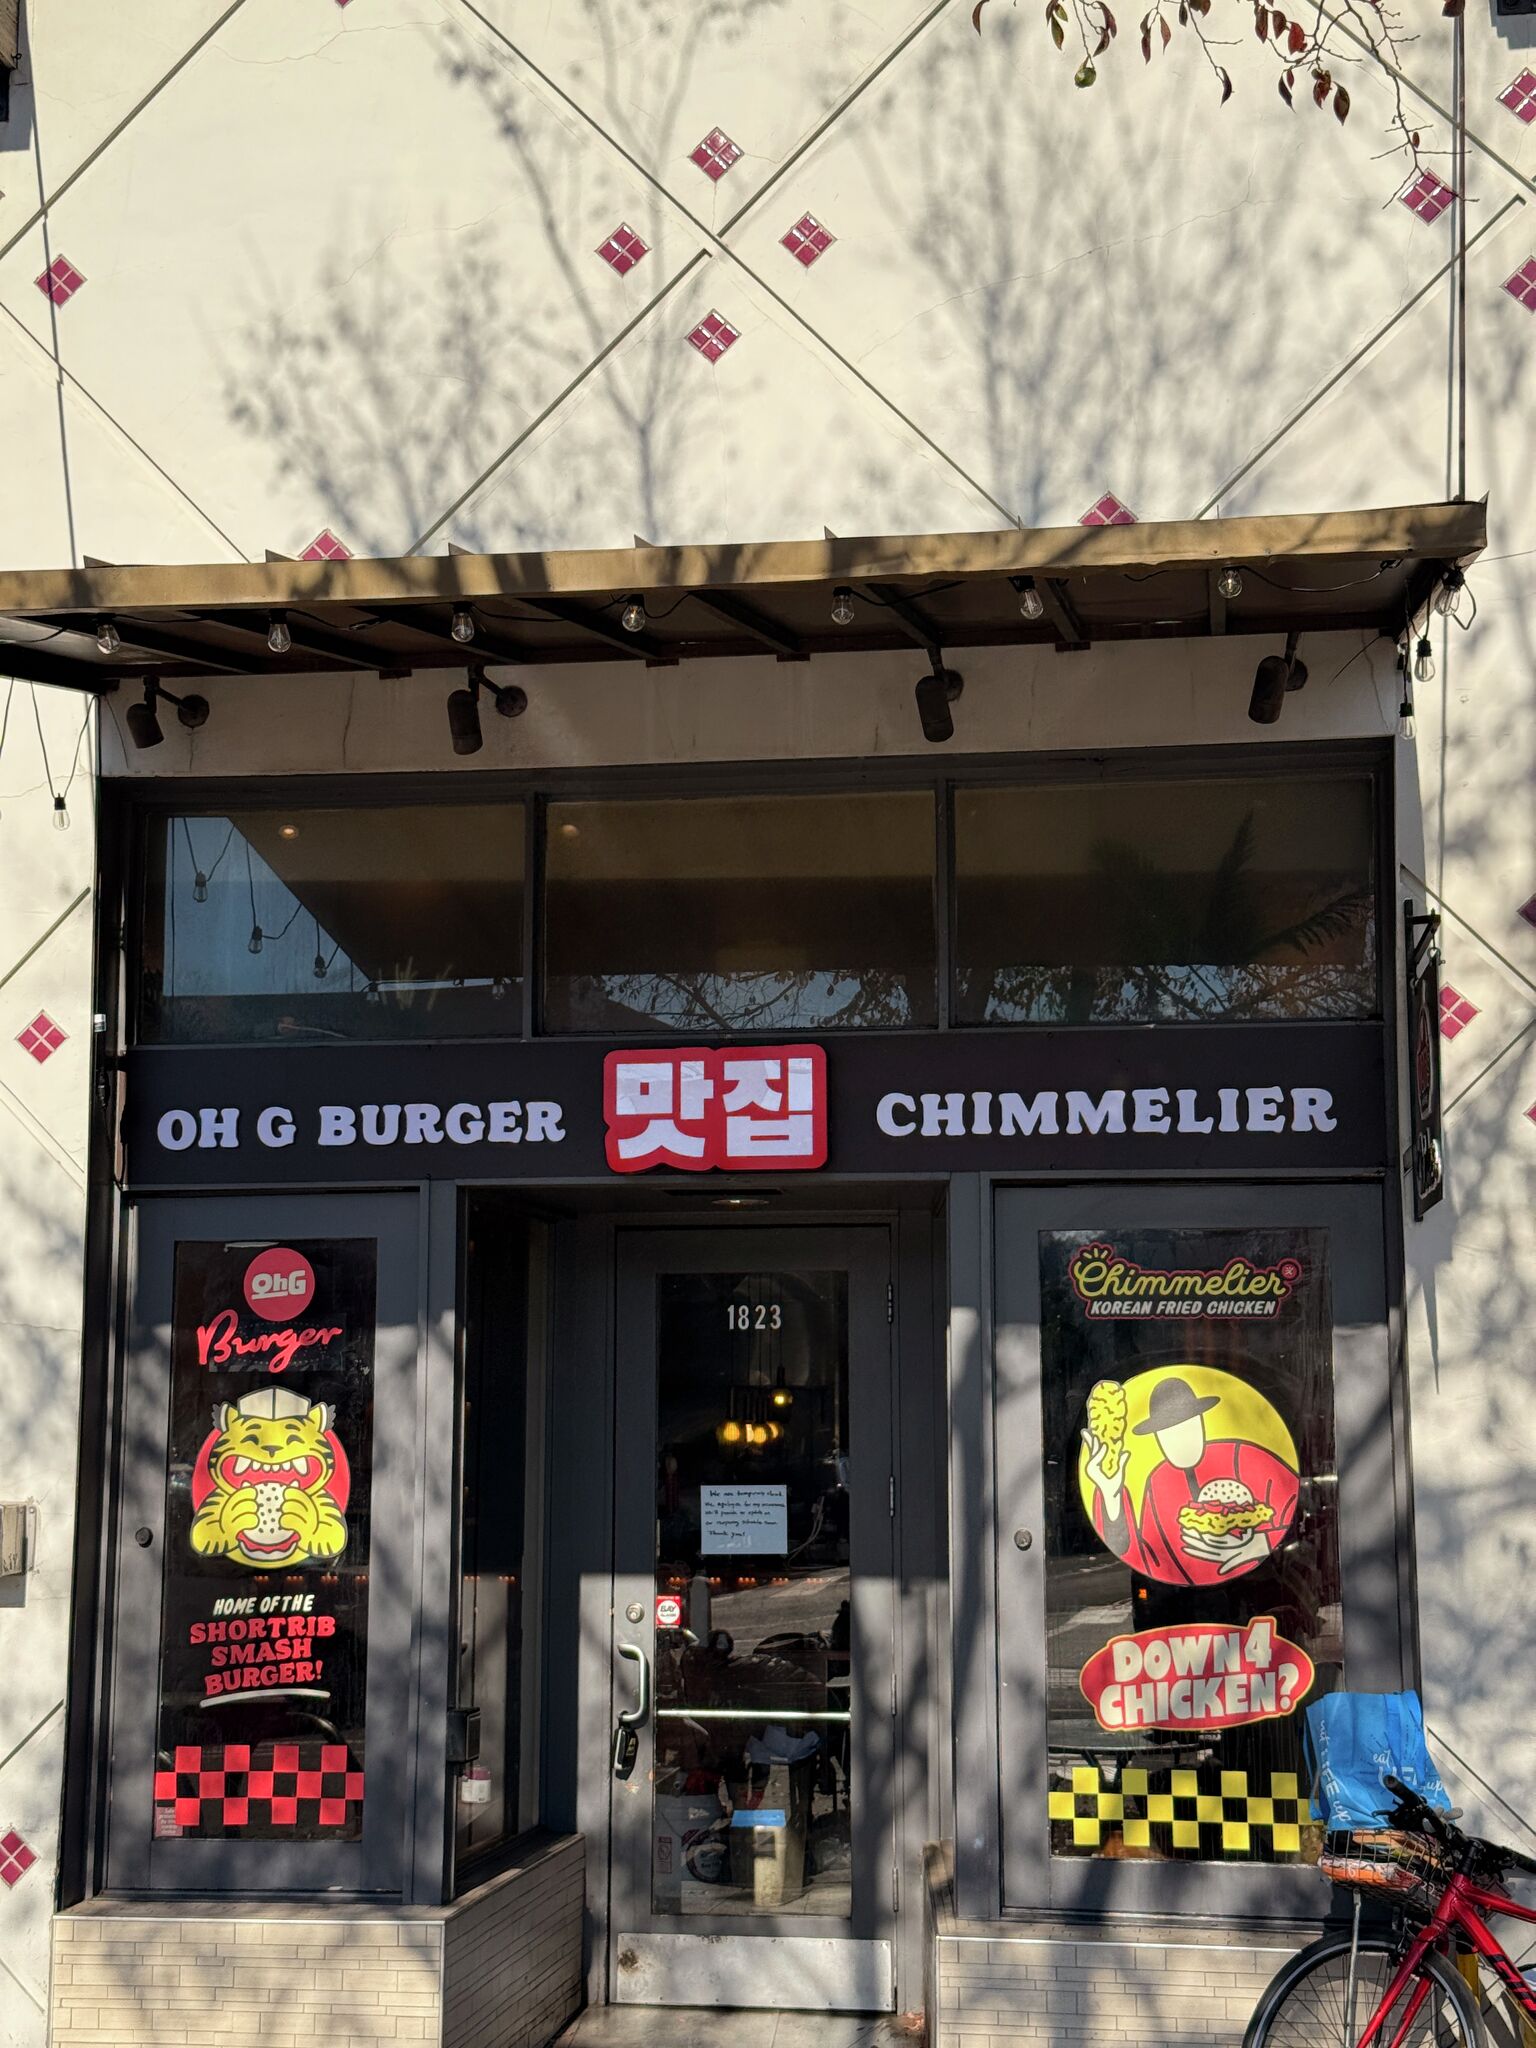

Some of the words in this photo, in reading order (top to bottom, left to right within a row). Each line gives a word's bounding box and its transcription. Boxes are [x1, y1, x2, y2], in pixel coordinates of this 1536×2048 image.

[156, 1107, 240, 1151] OH
[256, 1105, 296, 1148] G
[317, 1100, 566, 1146] BURGER
[615, 1057, 814, 1160] 맛집
[875, 1086, 1338, 1137] CHIMMELIER
[251, 1269, 307, 1300] OhG
[1074, 1260, 1287, 1297] Chimmelier
[727, 1304, 782, 1330] 1823
[1090, 1300, 1152, 1315] KOREAN
[1156, 1300, 1203, 1315] FRIED
[1206, 1300, 1276, 1315] CHICKEN
[196, 1308, 343, 1374] Burger
[213, 1596, 257, 1616] HOME
[259, 1595, 281, 1614] OF
[280, 1593, 315, 1612] THE
[211, 1638, 313, 1667] SMASH
[1112, 1632, 1242, 1683] DOWN
[1243, 1622, 1272, 1669] 4
[204, 1660, 323, 1696] BURGER!
[1099, 1662, 1300, 1726] CHICKEN?
